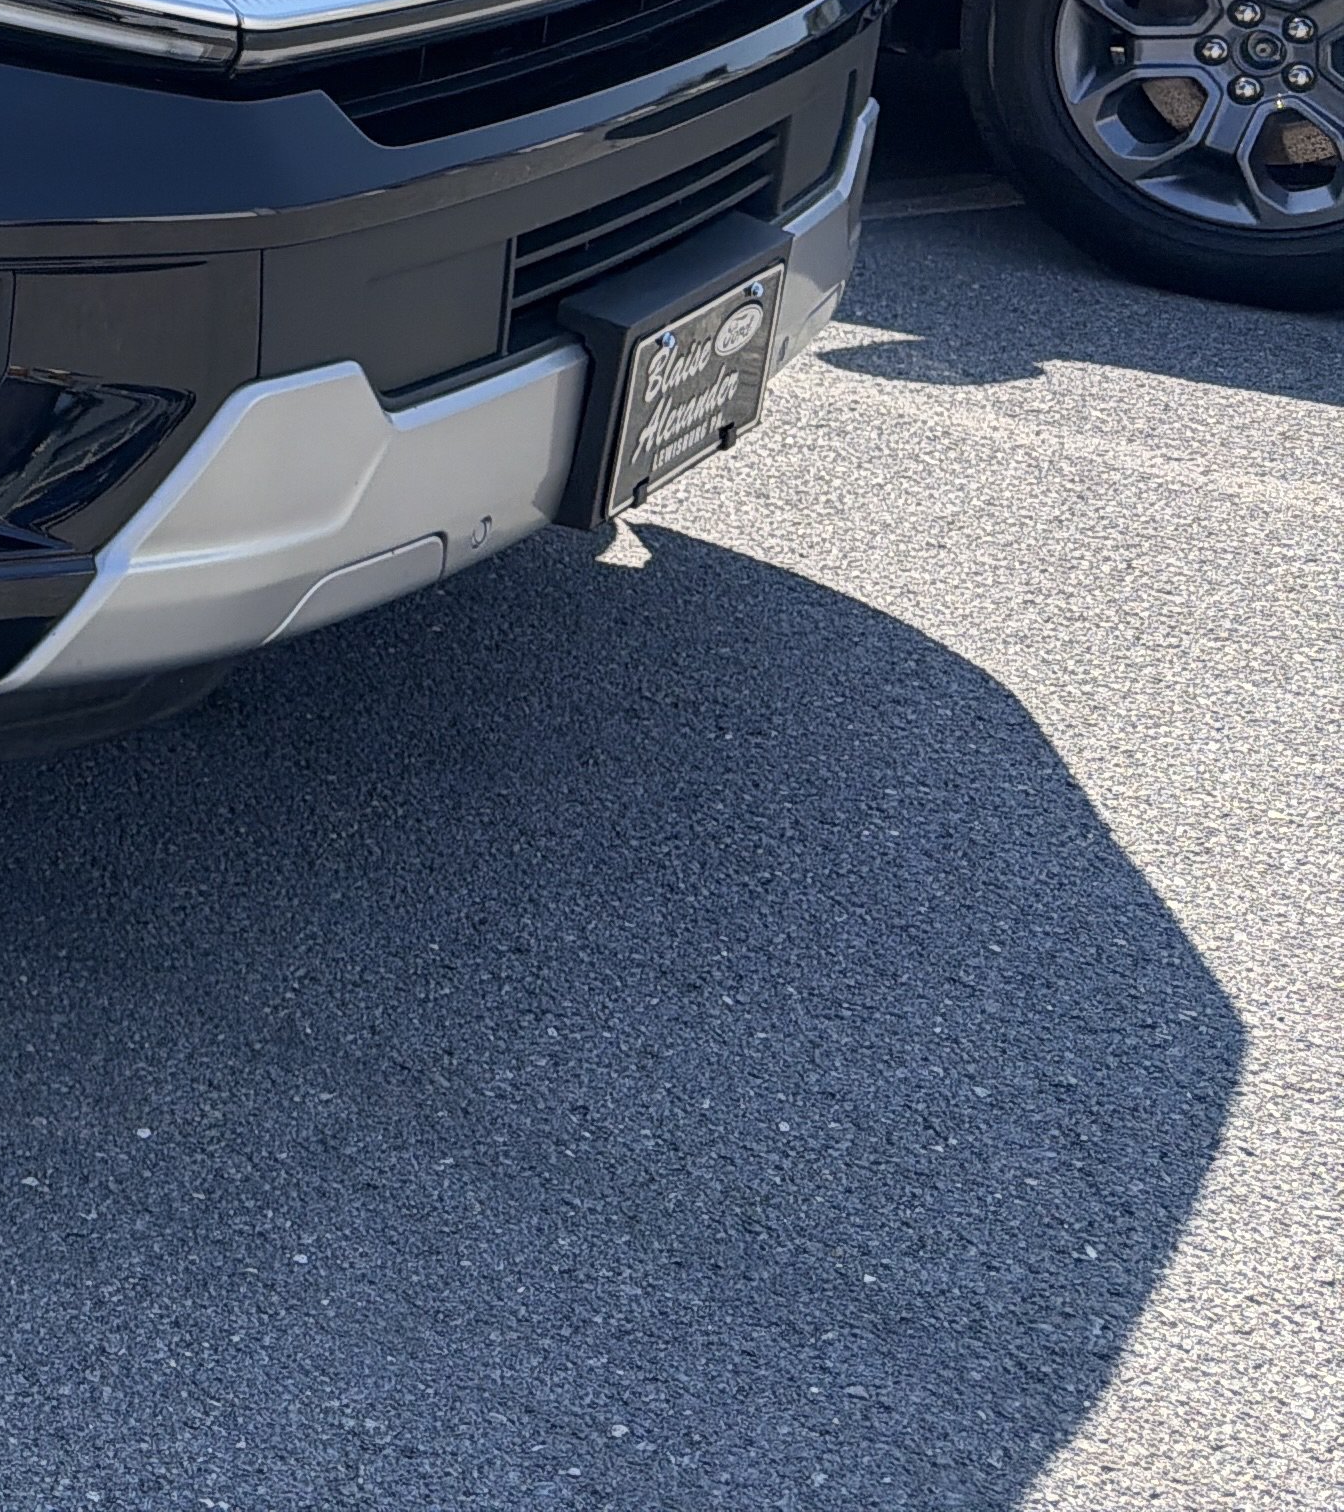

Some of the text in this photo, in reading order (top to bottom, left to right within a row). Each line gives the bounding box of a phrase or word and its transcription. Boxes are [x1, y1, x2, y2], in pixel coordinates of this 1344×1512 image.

[644, 339, 711, 403] Blaise
[632, 361, 740, 465] Alexander
[652, 420, 709, 472] LEWISBURG
